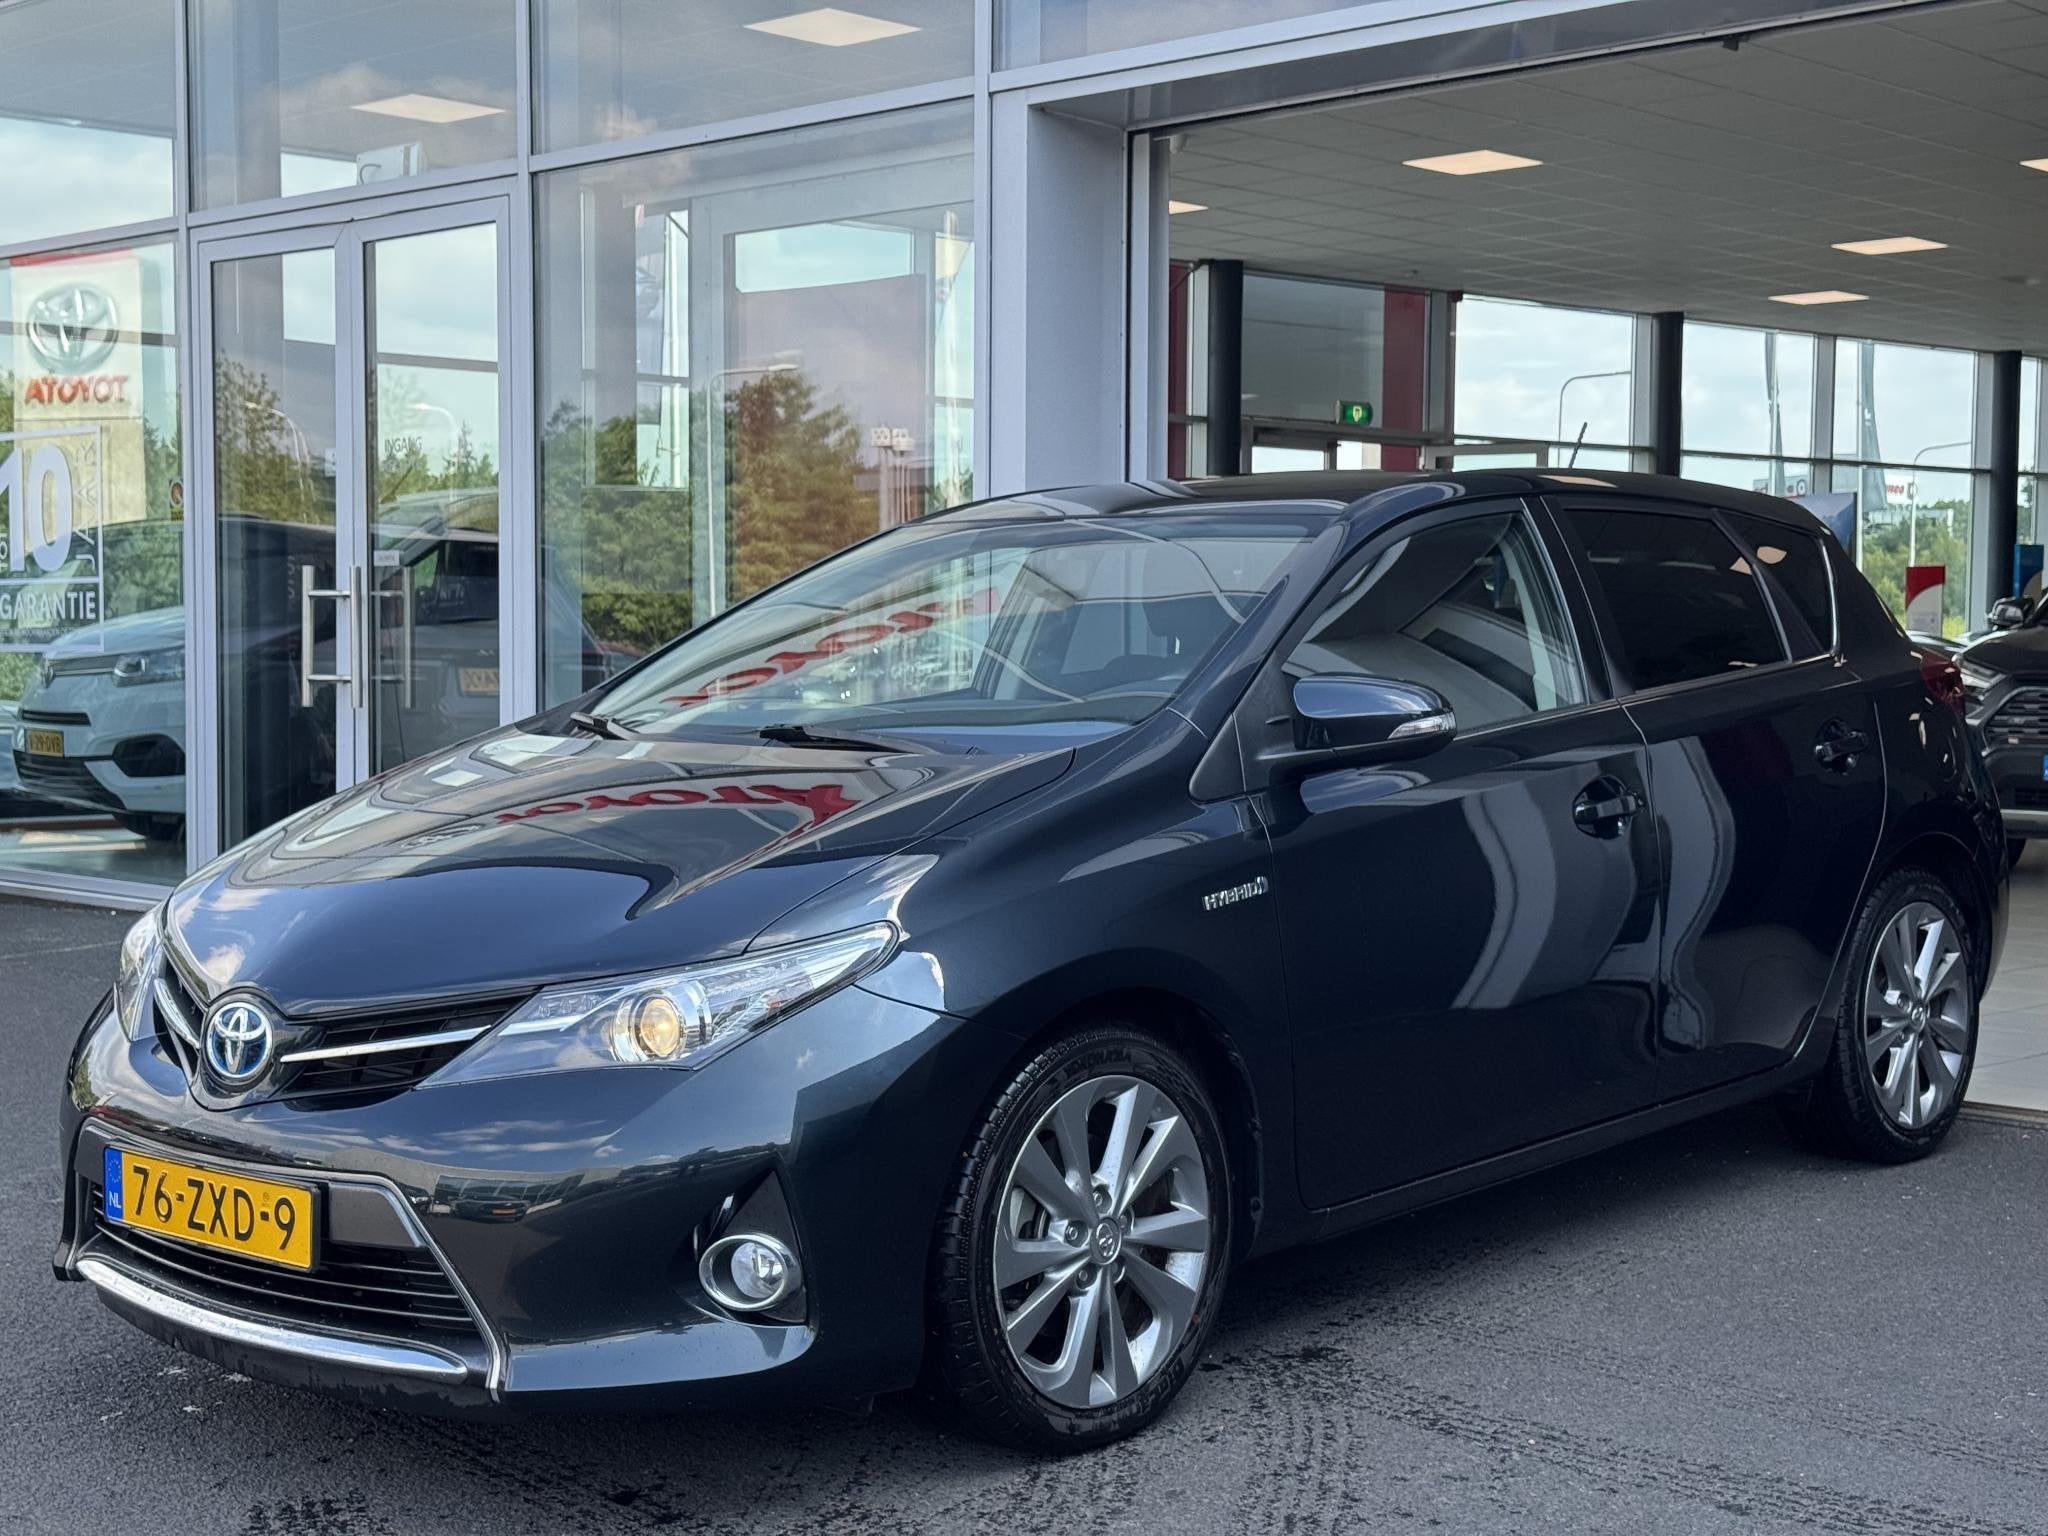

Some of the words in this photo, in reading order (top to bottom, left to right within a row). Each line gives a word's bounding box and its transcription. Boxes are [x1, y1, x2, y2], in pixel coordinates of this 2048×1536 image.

[0, 444, 73, 572] 10
[0, 591, 97, 620] GARANTIE
[1202, 879, 1265, 911] HYBRID
[108, 1190, 122, 1210] NL
[133, 1165, 296, 1250] 76-ZXD-9
